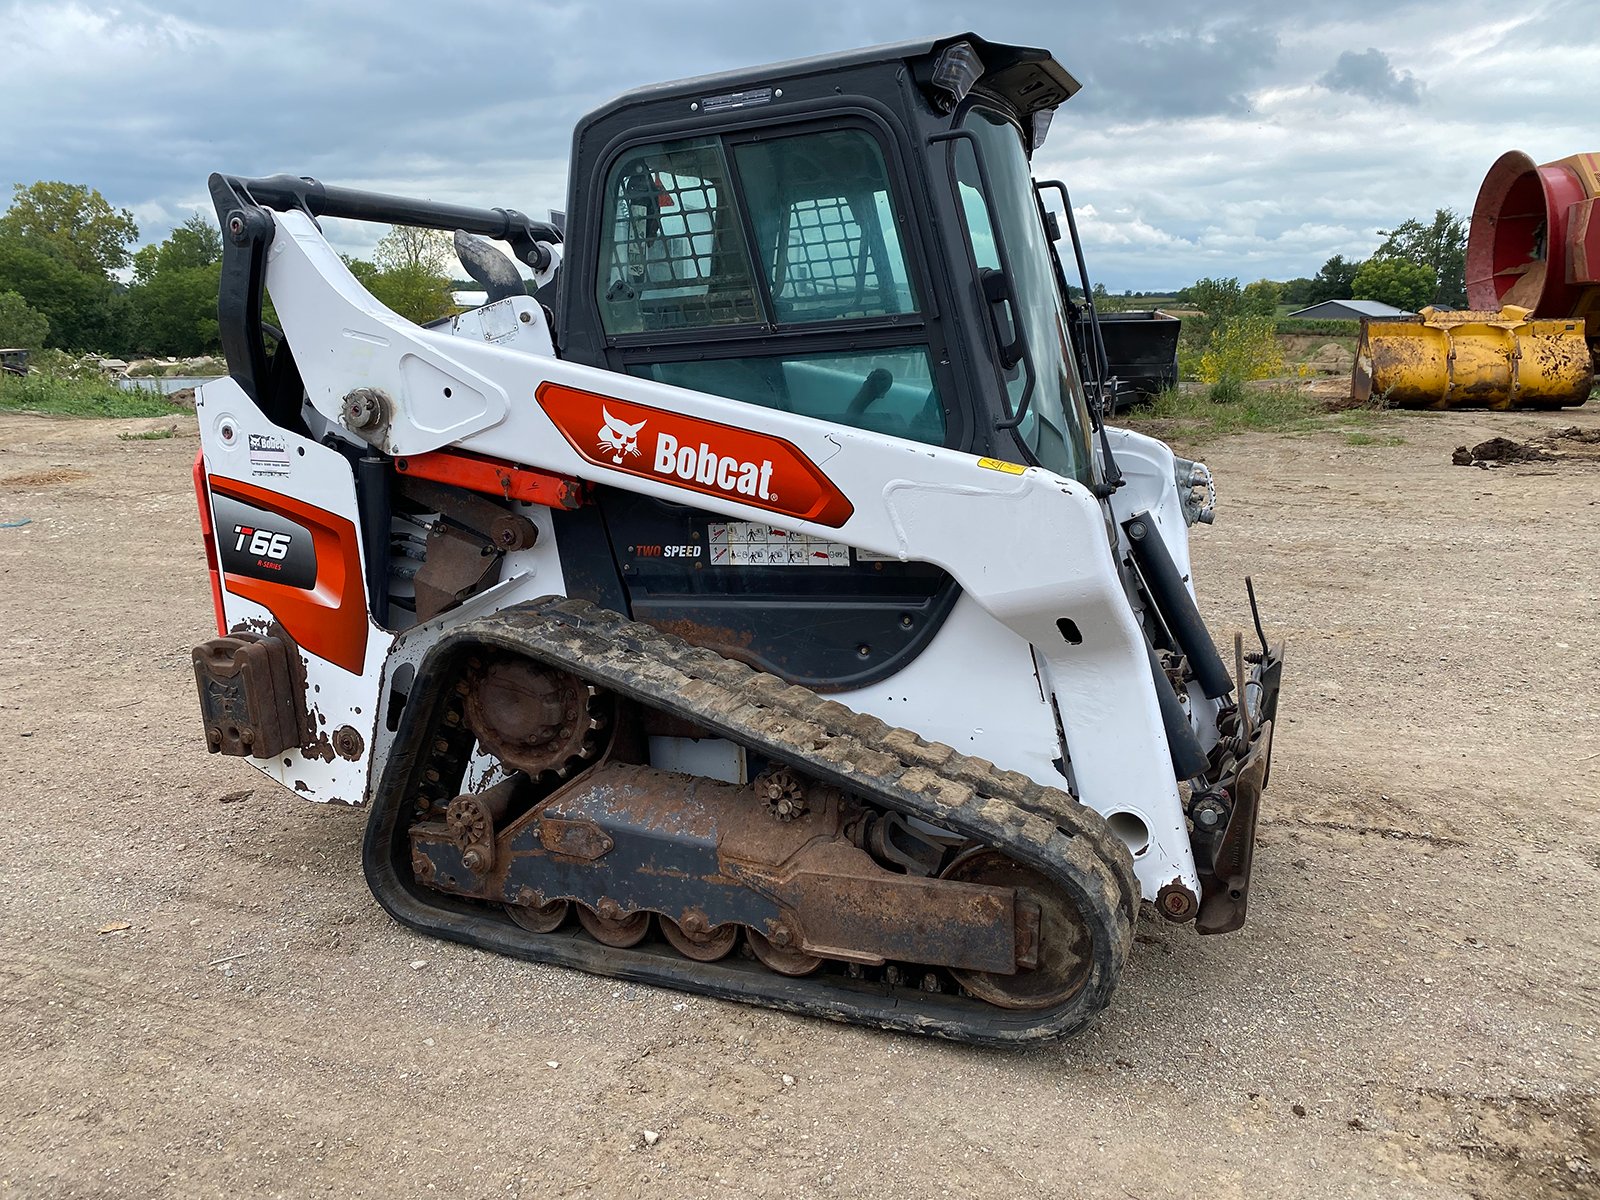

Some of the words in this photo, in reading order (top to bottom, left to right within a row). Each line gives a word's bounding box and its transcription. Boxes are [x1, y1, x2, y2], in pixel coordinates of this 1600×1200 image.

[654, 433, 773, 500] Bobcat
[234, 525, 292, 560] T66
[637, 544, 661, 557] TWO
[664, 545, 701, 558] SPEED
[257, 559, 282, 570] R-SERIES
